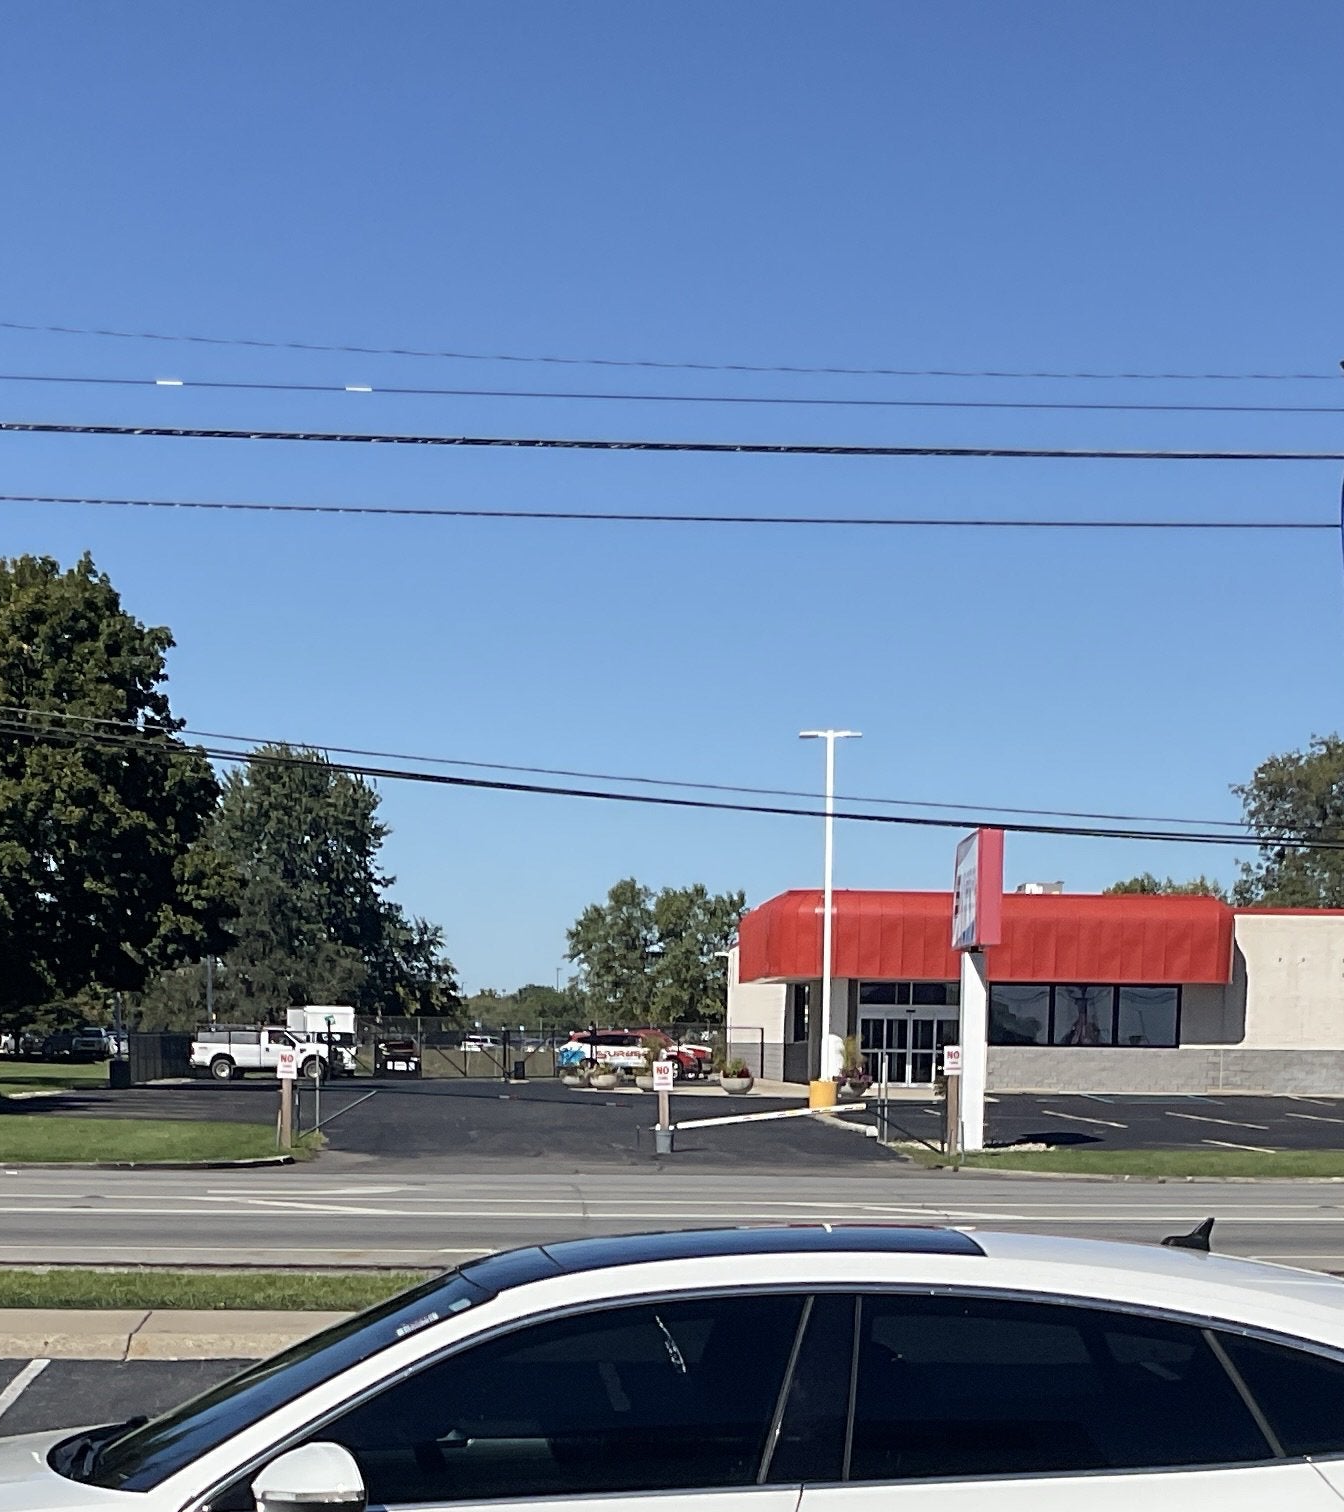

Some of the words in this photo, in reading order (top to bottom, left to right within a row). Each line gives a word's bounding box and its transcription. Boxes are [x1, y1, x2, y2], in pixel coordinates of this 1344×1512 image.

[280, 1054, 294, 1063] NO
[947, 1050, 960, 1060] NO
[656, 1066, 670, 1075] NO
